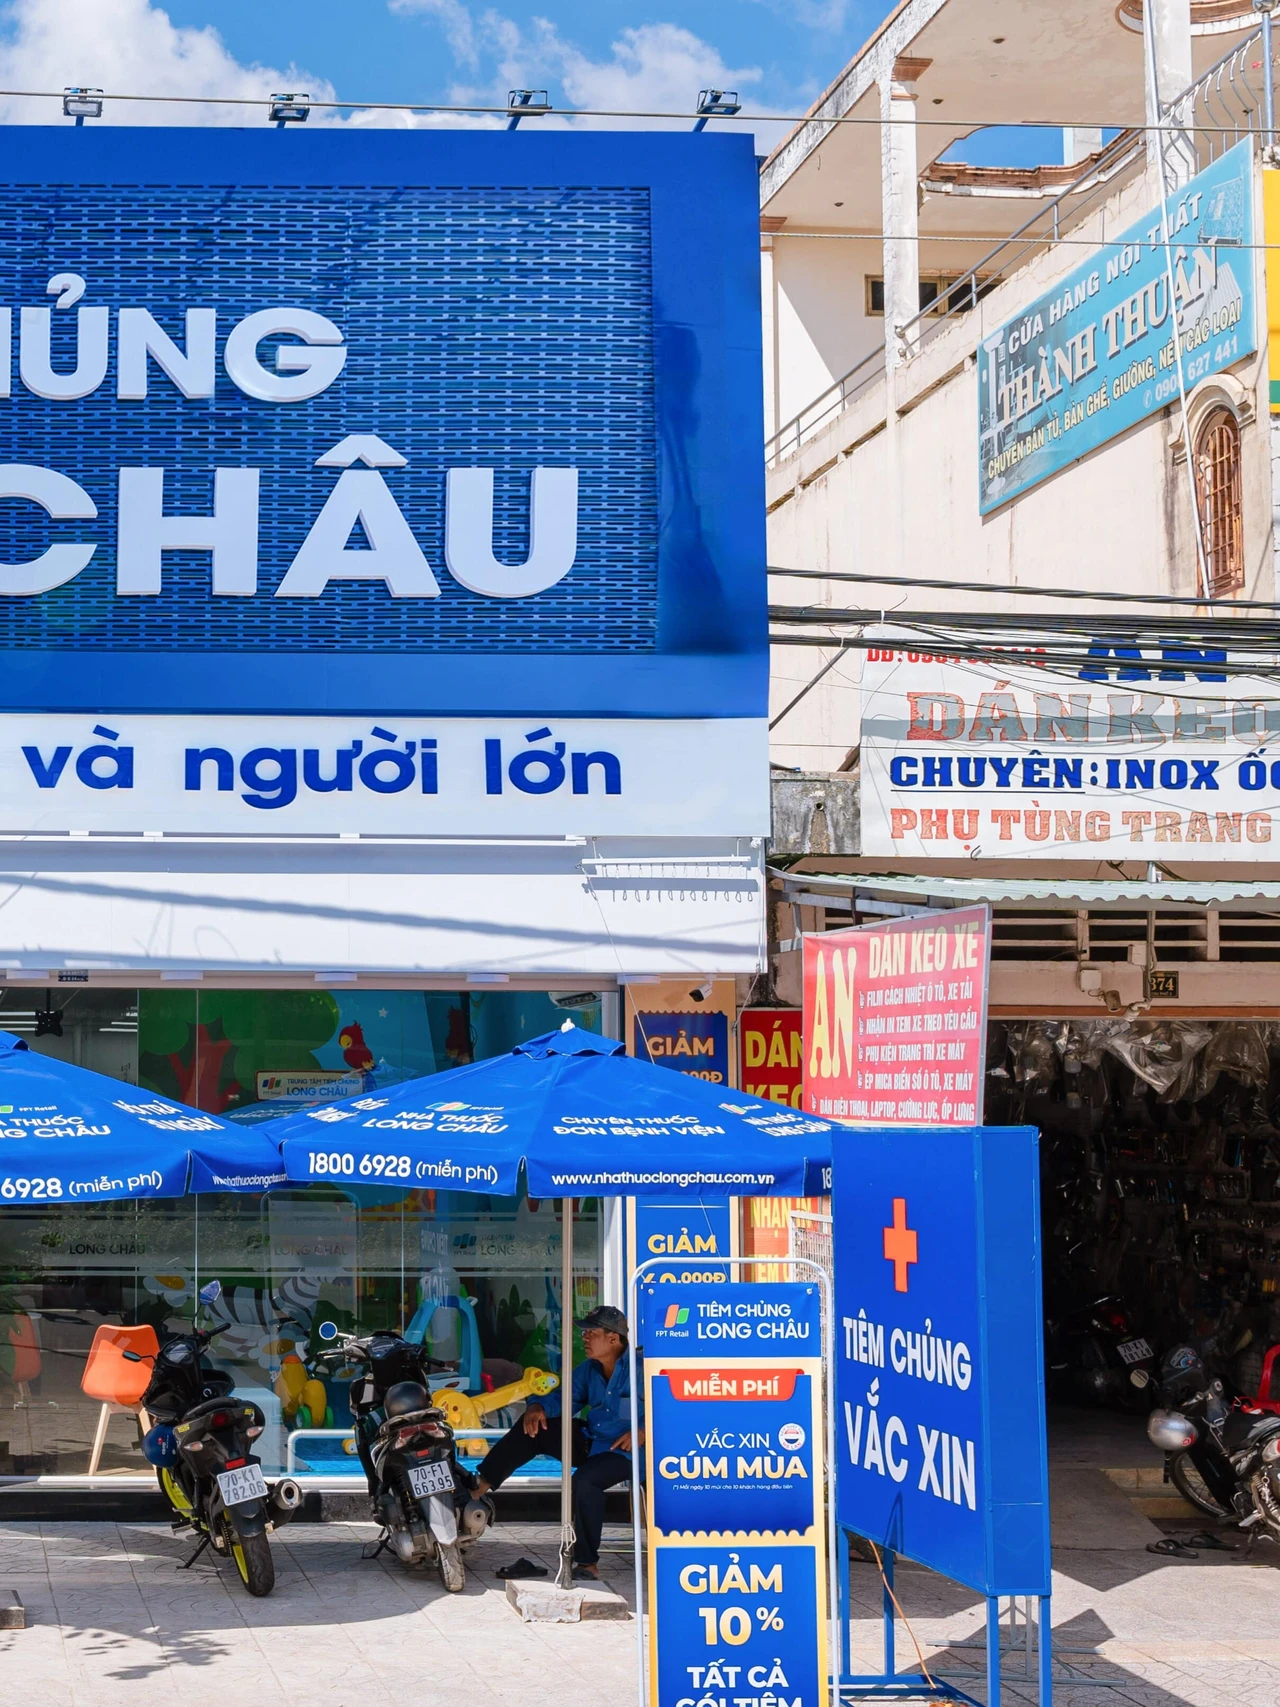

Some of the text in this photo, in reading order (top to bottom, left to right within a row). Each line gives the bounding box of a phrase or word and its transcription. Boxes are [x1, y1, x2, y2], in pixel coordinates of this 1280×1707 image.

[1007, 192, 1203, 355] CỬA HÀNG NỘI THẤT
[997, 236, 1218, 428] THÀNH THUẬN
[1188, 334, 1239, 382] 627 441
[988, 445, 1024, 480] CHUYÊN
[1024, 427, 1045, 456] BÁN
[1064, 404, 1084, 432] BÀN
[1186, 317, 1211, 353] CÁC
[1213, 296, 1241, 334] LOẠI
[907, 680, 1092, 742] DÁN
[22, 725, 134, 788] và
[185, 727, 438, 810] người
[486, 727, 621, 795] lớn
[890, 800, 1272, 851] PHỤ TÙNG TRANG
[869, 921, 979, 979] DÁN KEO XE
[866, 988, 884, 1007] FILM
[884, 983, 904, 1005] CÁCH
[904, 984, 926, 1009] NHIỆT
[947, 982, 959, 1001] XE
[960, 976, 973, 999] TẢI
[809, 947, 857, 1079] AN
[744, 1020, 803, 1068] DÁN
[865, 1039, 966, 1067] PHỤ KIỆN TRANG TRÍ XE MÁY
[286, 1084, 348, 1096] LONG CHÂU
[9, 1115, 84, 1127] THUỐC
[34, 1124, 112, 1138] CHÂU
[552, 1126, 607, 1136] ĐƠN
[609, 1126, 670, 1137] BỆNH
[672, 1125, 725, 1137] VIỆN
[561, 1115, 700, 1125] CHUYÊN THUỐC
[308, 1152, 498, 1185] 1800 6928 (miễn phí)
[552, 1171, 775, 1188] www.nhathuoclongchau.com.vn
[0, 1177, 64, 1199] 6928
[69, 1175, 124, 1197] (miễn
[127, 1170, 162, 1192] phí)
[647, 1227, 716, 1254] GIẢM
[697, 1299, 792, 1317] TIÊM CHỦNG
[697, 1318, 810, 1339] LONG CHÂU
[842, 1308, 972, 1391] TIÊM CHỦNG
[683, 1372, 780, 1396] MIỄN PHÍ
[695, 1427, 735, 1449] VẮC
[738, 1432, 770, 1449] XIN
[843, 1376, 977, 1512] VẮC XIN
[223, 1467, 257, 1489] 70-K1
[413, 1463, 444, 1482] 70-F1
[659, 1450, 808, 1480] CÚM MÙA
[223, 1480, 265, 1506] 782.06
[414, 1474, 453, 1496] 663.95
[679, 1553, 783, 1594] GIẢM
